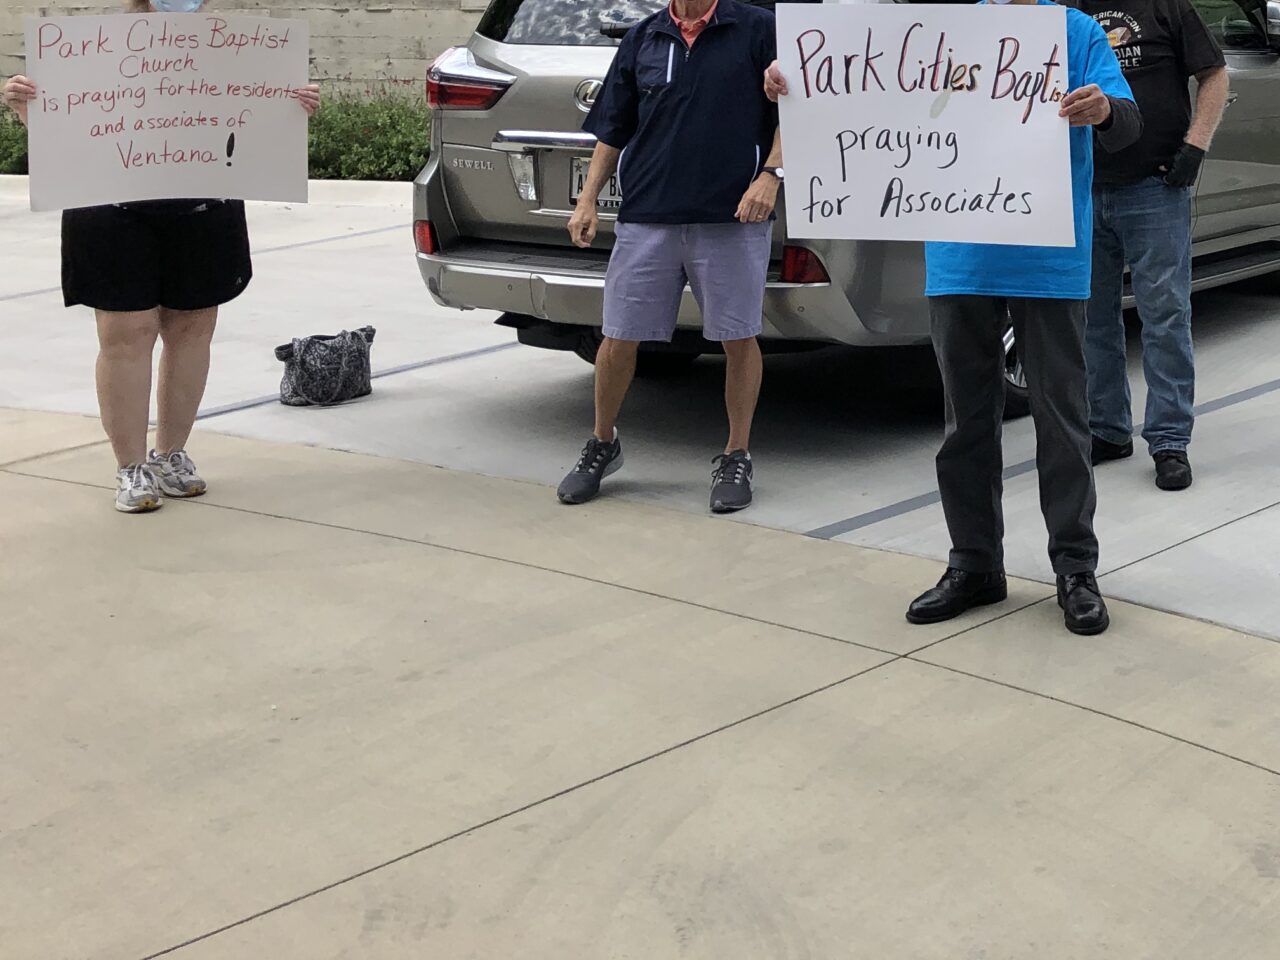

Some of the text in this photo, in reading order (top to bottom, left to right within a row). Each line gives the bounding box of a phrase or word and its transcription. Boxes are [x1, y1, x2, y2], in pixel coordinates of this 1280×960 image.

[38, 17, 290, 60] Park Cities Baptist
[119, 55, 200, 79] Church
[796, 27, 886, 99] Park
[898, 22, 982, 93] Cities
[42, 76, 300, 115] is praying for the residents
[90, 109, 252, 137] and associates of
[452, 157, 494, 171] SEWELL
[836, 125, 959, 182] praying
[802, 175, 1033, 223] for Associates
